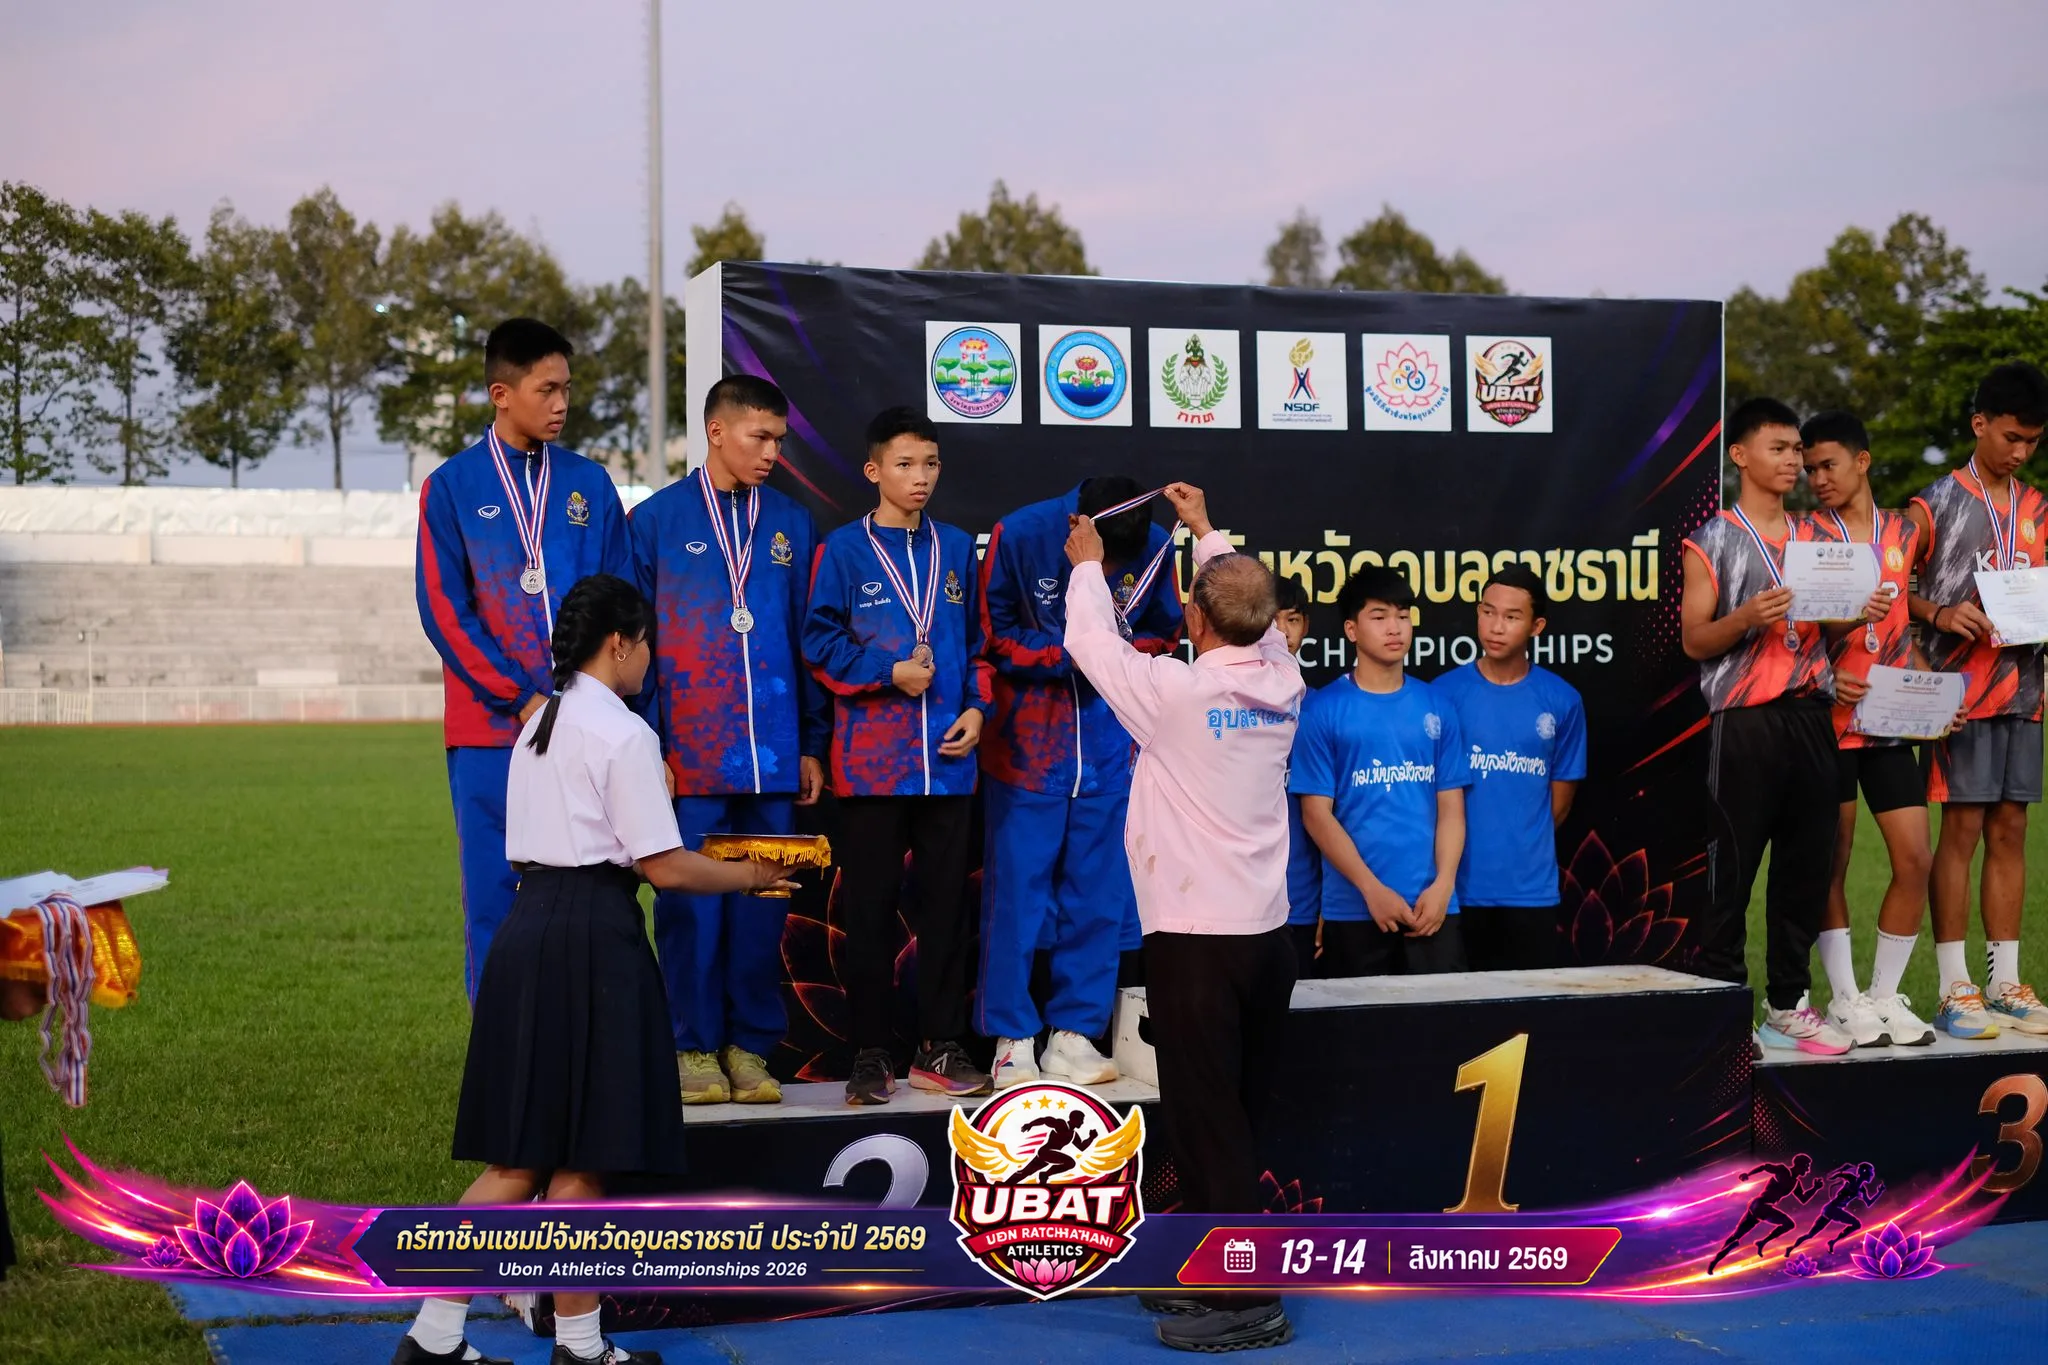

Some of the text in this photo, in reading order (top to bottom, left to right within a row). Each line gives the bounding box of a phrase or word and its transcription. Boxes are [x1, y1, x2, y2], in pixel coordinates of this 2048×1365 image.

[1284, 402, 1320, 412] NSDF
[1481, 385, 1540, 402] UBAT
[1296, 633, 1614, 668] CHPIOHIPS
[1443, 1034, 1528, 1213] 1
[1970, 1073, 2048, 1193] 3
